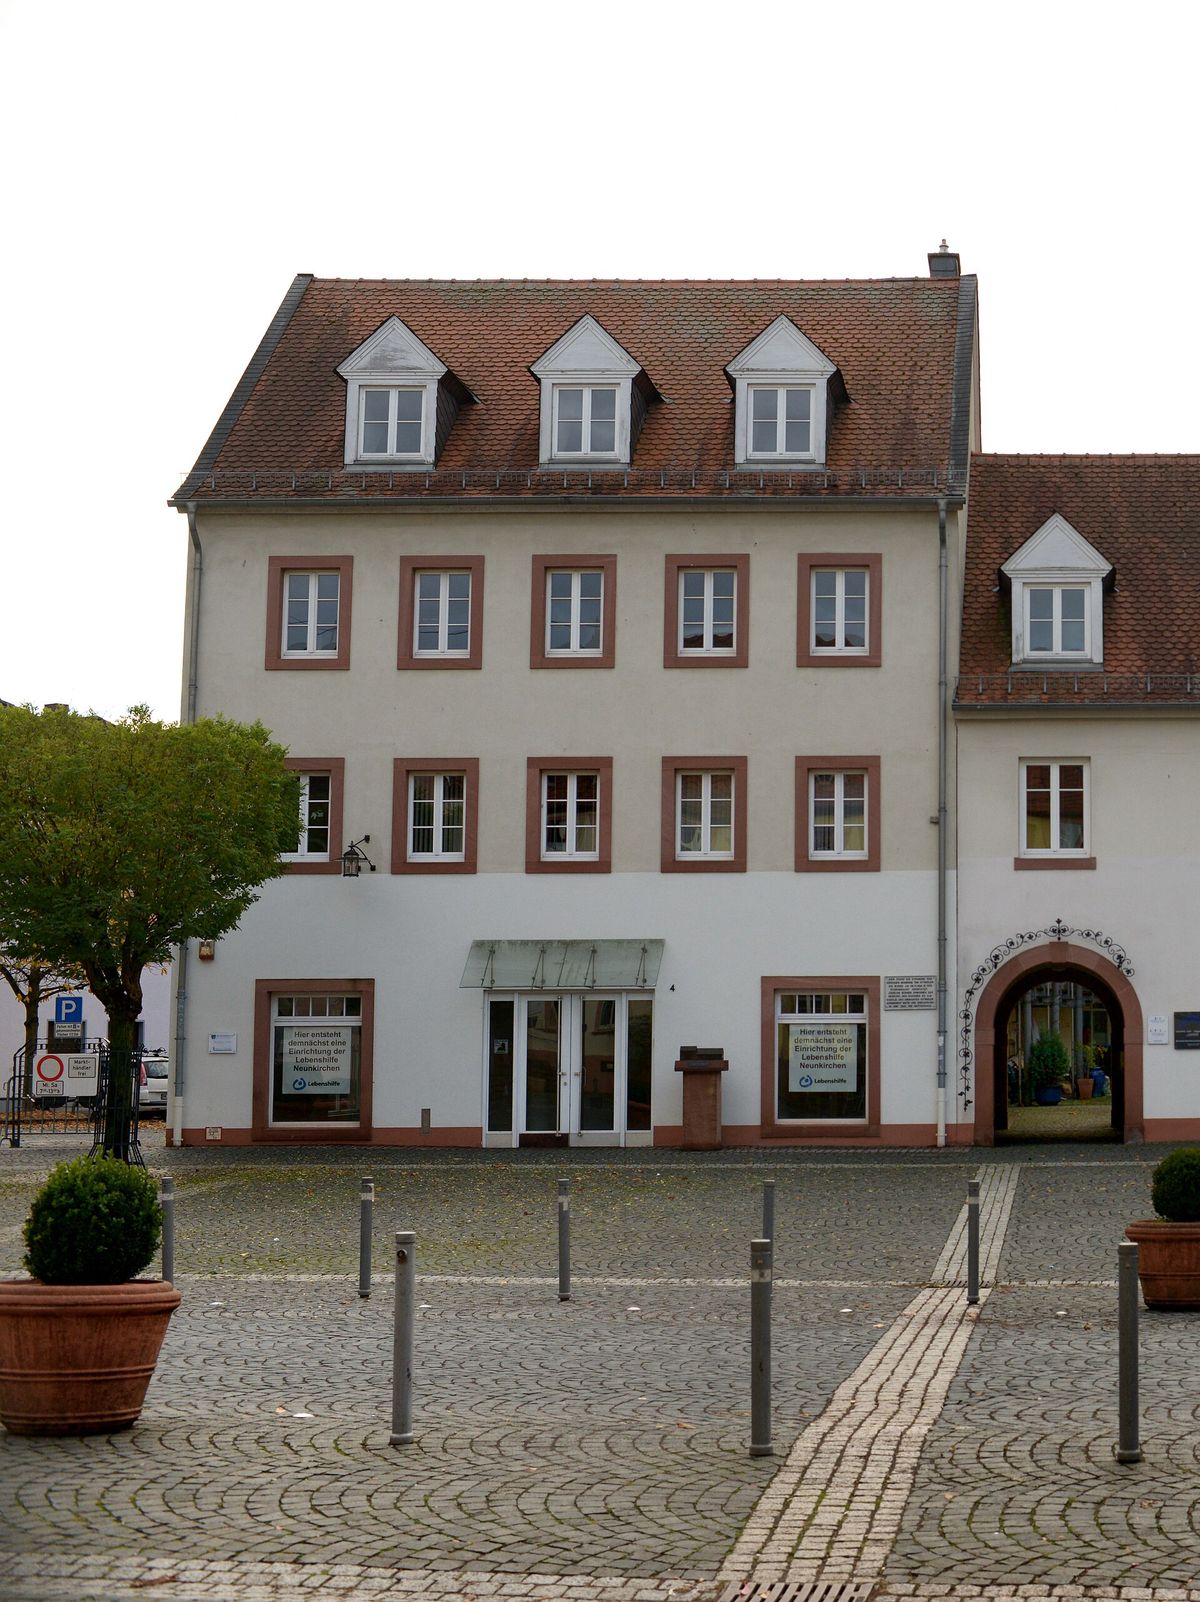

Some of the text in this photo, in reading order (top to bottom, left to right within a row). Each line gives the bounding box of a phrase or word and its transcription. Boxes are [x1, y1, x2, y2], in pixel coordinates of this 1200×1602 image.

[669, 984, 676, 992] 4
[62, 1000, 77, 1021] P
[288, 1048, 331, 1056] Einrichtung
